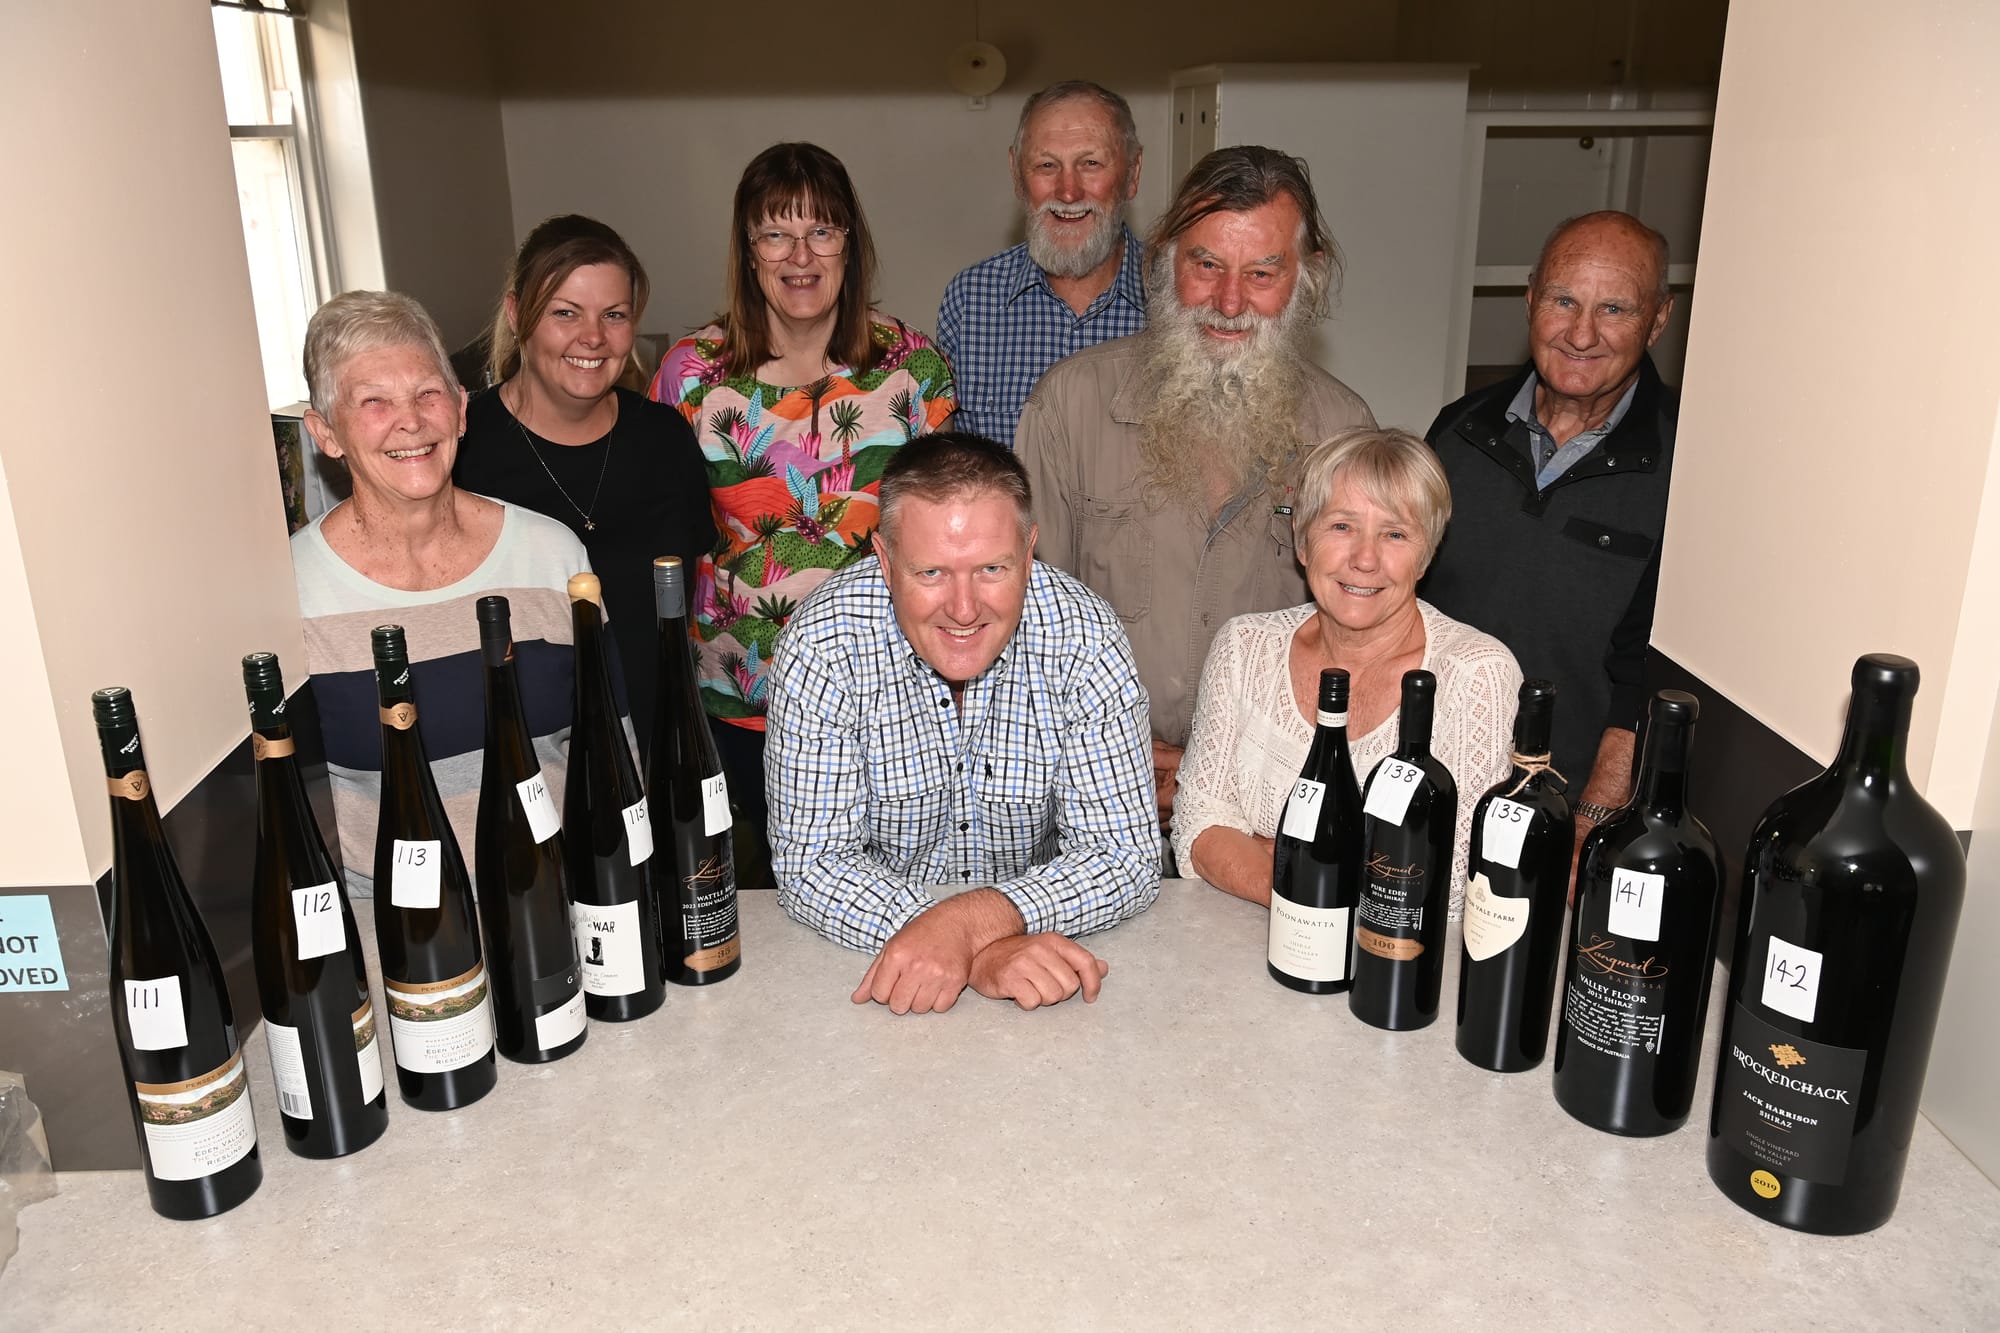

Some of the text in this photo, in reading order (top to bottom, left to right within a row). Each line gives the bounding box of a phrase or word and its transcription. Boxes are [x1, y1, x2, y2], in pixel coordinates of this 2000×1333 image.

[1383, 762, 1417, 783] 138
[526, 781, 544, 803] 114
[708, 779, 724, 798] 116
[1292, 782, 1319, 804] 137
[629, 803, 645, 825] 115
[1491, 801, 1529, 823] 135
[397, 845, 427, 867] 113
[1364, 853, 1425, 878] Langmeil
[696, 889, 724, 902] WATTLE
[1370, 883, 1408, 898] PURE EDEN
[1384, 894, 1405, 902] SHIRAZ
[1615, 876, 1646, 908] 141
[303, 891, 333, 917] 112
[1475, 904, 1492, 917] VALE
[1493, 912, 1515, 922] FARM
[592, 921, 615, 933] WAR
[1276, 906, 1335, 928] POONAWATTA
[1372, 938, 1396, 950] 100
[1575, 932, 1669, 979] Langmeil
[1608, 974, 1662, 990] BAROSSA
[1769, 952, 1808, 992] 142
[133, 986, 159, 1010] 111
[421, 984, 448, 993] PEWSEY
[1580, 974, 1609, 994] VALLEY
[1612, 990, 1647, 1004] FLOOR
[1587, 988, 1602, 1000] 2013
[1604, 996, 1633, 1009] SHIRAZ
[426, 1047, 448, 1055] EDEN
[450, 1038, 476, 1051] VALLEY
[1603, 1048, 1630, 1059] AUSTRALIA
[435, 1052, 471, 1065] RIESLING
[1733, 1045, 1850, 1105] BROCKENCHACK
[1742, 1090, 1818, 1126] JACK HARRISON
[1759, 1109, 1793, 1129] SHIRAZ
[195, 1146, 219, 1157] EDEN
[221, 1128, 246, 1147] VALLEY
[1745, 1130, 1800, 1158] SINGLE VINEYARD
[1750, 1140, 1792, 1163] EDEN VALLEY
[206, 1145, 243, 1167] RIESLING
[1754, 1150, 1783, 1167] BAROSSA
[1753, 1177, 1777, 1193] 2019
